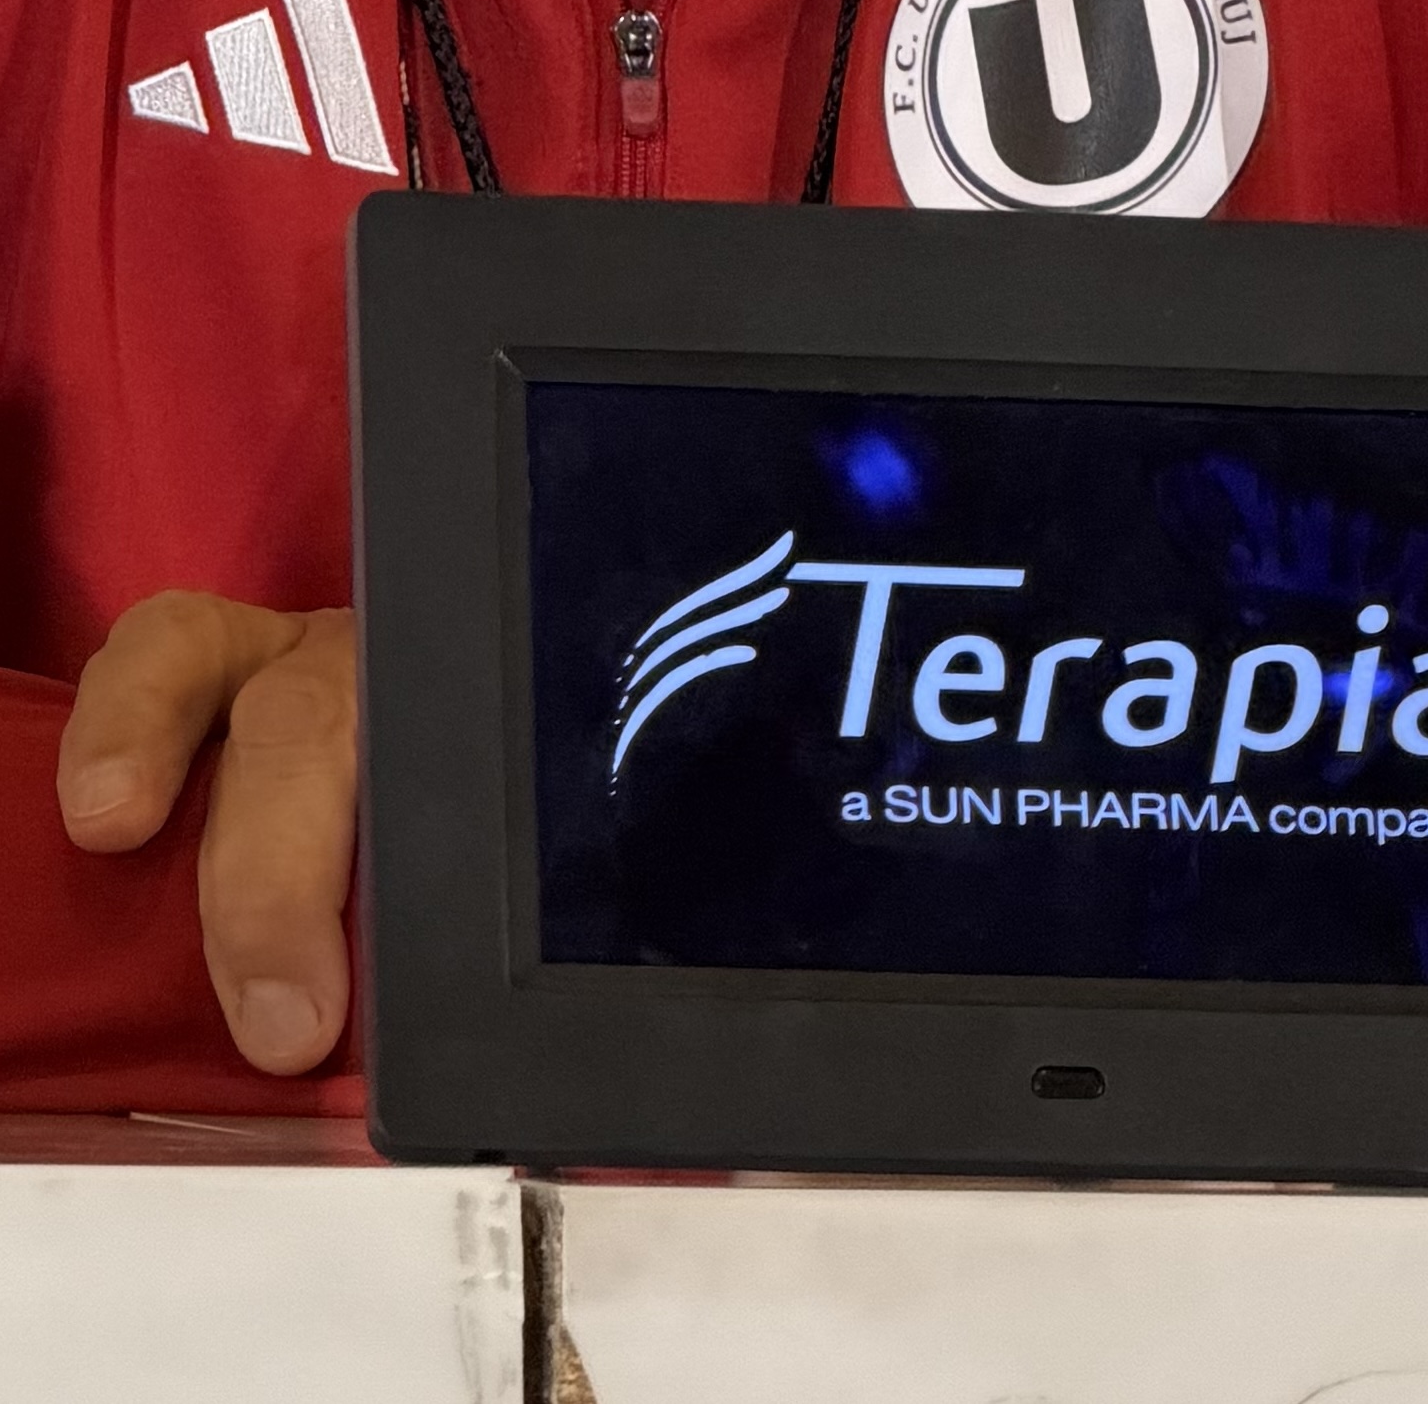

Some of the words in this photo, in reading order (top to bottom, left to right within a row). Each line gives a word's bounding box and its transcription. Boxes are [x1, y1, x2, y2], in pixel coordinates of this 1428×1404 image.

[892, 31, 920, 115] F.C.
[840, 790, 873, 823] a
[883, 783, 1003, 826] SUN
[1016, 787, 1260, 834] PHARMA
